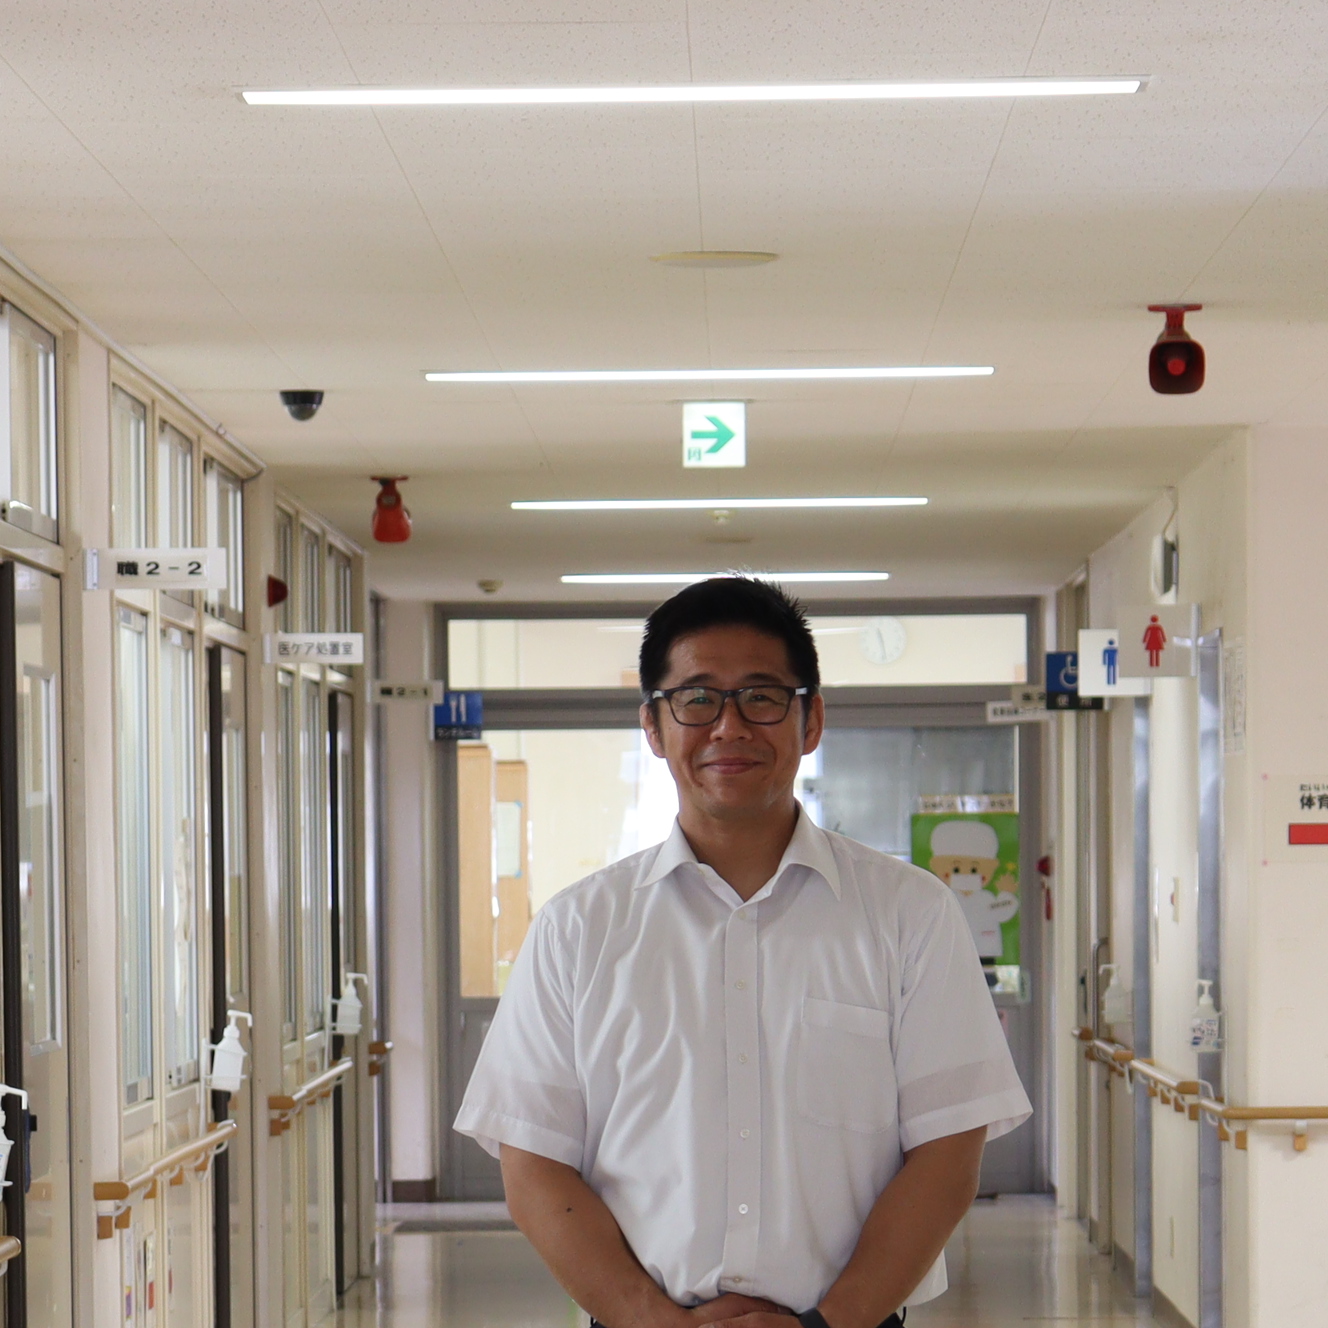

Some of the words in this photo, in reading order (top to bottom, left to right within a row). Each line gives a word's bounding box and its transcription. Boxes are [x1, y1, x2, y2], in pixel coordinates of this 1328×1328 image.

[278, 641, 353, 656] 医ケア処置室
